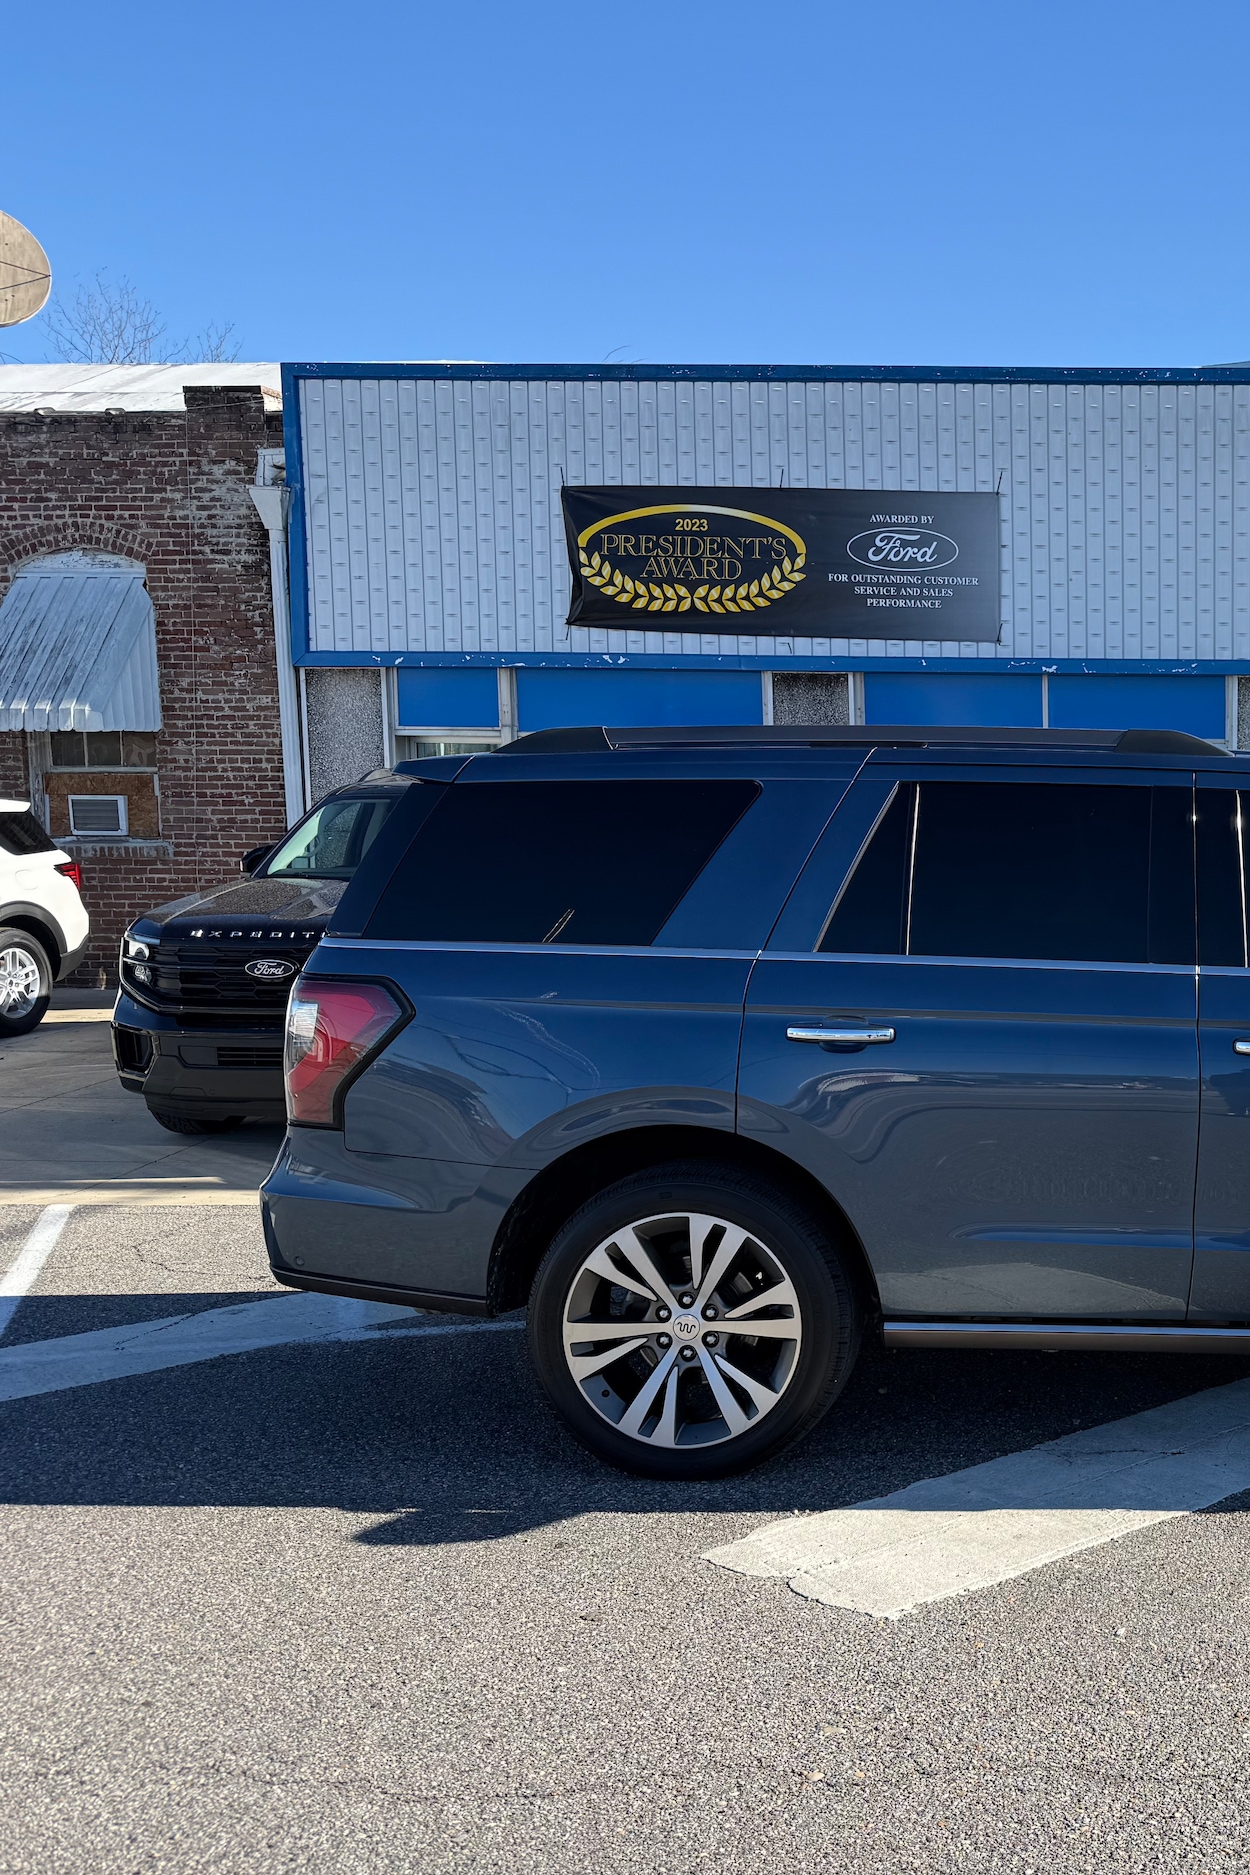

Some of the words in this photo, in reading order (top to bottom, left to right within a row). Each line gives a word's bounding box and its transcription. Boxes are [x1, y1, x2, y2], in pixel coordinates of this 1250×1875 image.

[674, 518, 709, 531] 2023
[869, 514, 918, 524] AWARDED
[921, 515, 934, 524] BY
[600, 534, 787, 559] PRESIDENT'S
[867, 532, 938, 563] Ford
[639, 556, 742, 580] AWARD
[828, 573, 849, 582] FOR
[851, 574, 922, 585] OUTSTANDING
[924, 576, 979, 586] CUSTOMER
[854, 586, 897, 596] SERVICE
[900, 587, 920, 596] AND
[922, 588, 953, 597] SALES
[866, 598, 942, 609] PERFORMANCE
[254, 961, 285, 975] Ford
